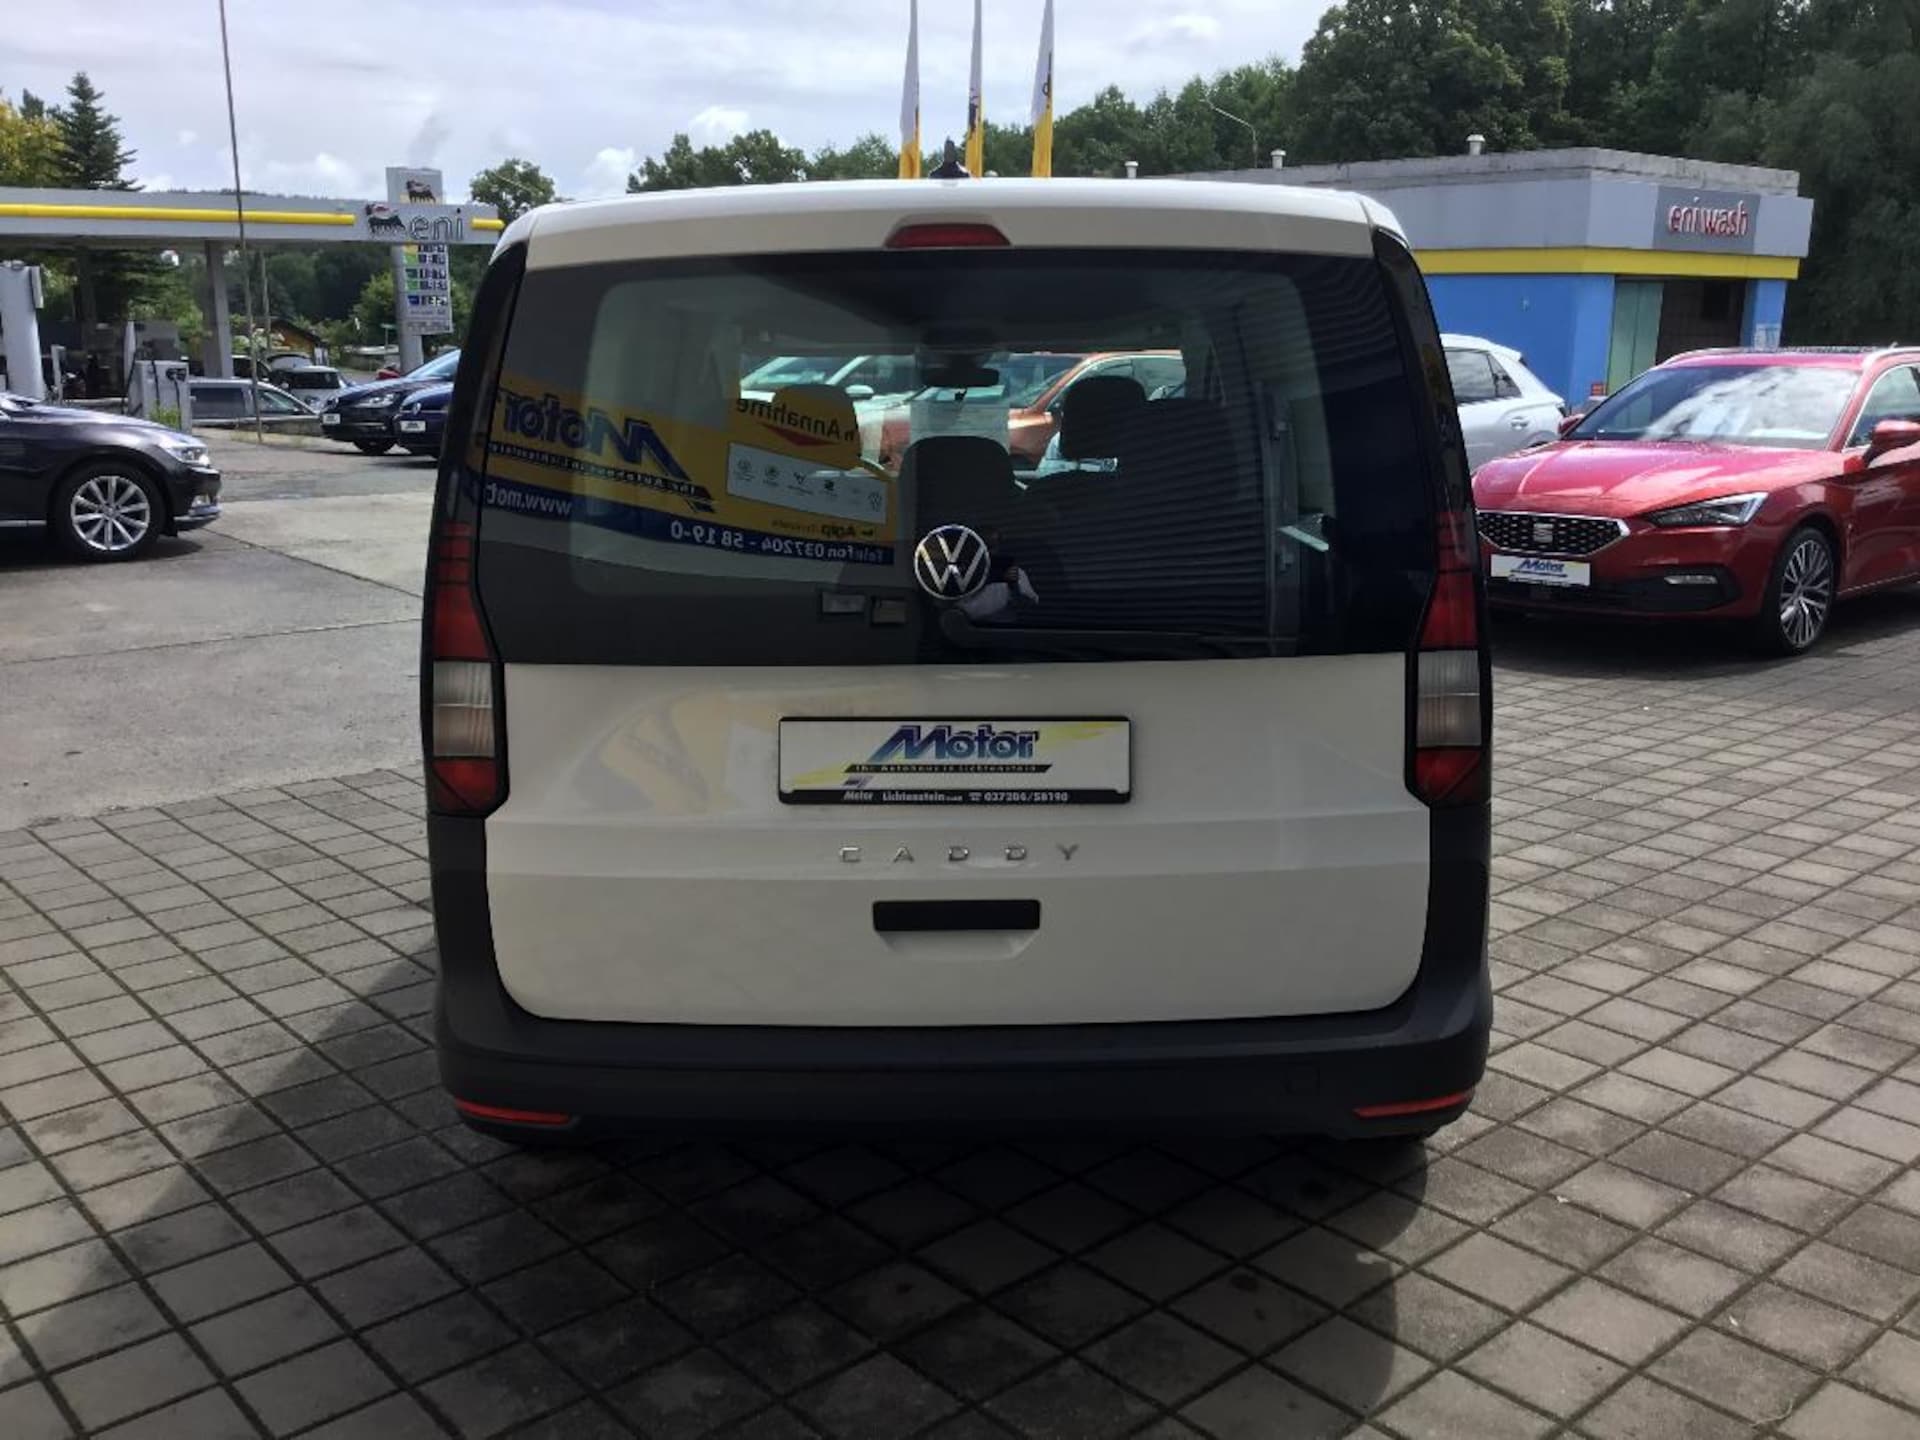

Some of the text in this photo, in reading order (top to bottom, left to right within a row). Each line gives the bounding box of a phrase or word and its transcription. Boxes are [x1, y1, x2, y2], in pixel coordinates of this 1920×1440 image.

[410, 207, 464, 241] eni
[1668, 196, 1749, 237] eni wash
[867, 724, 1038, 760] Motor
[838, 843, 1080, 864] CADDY
